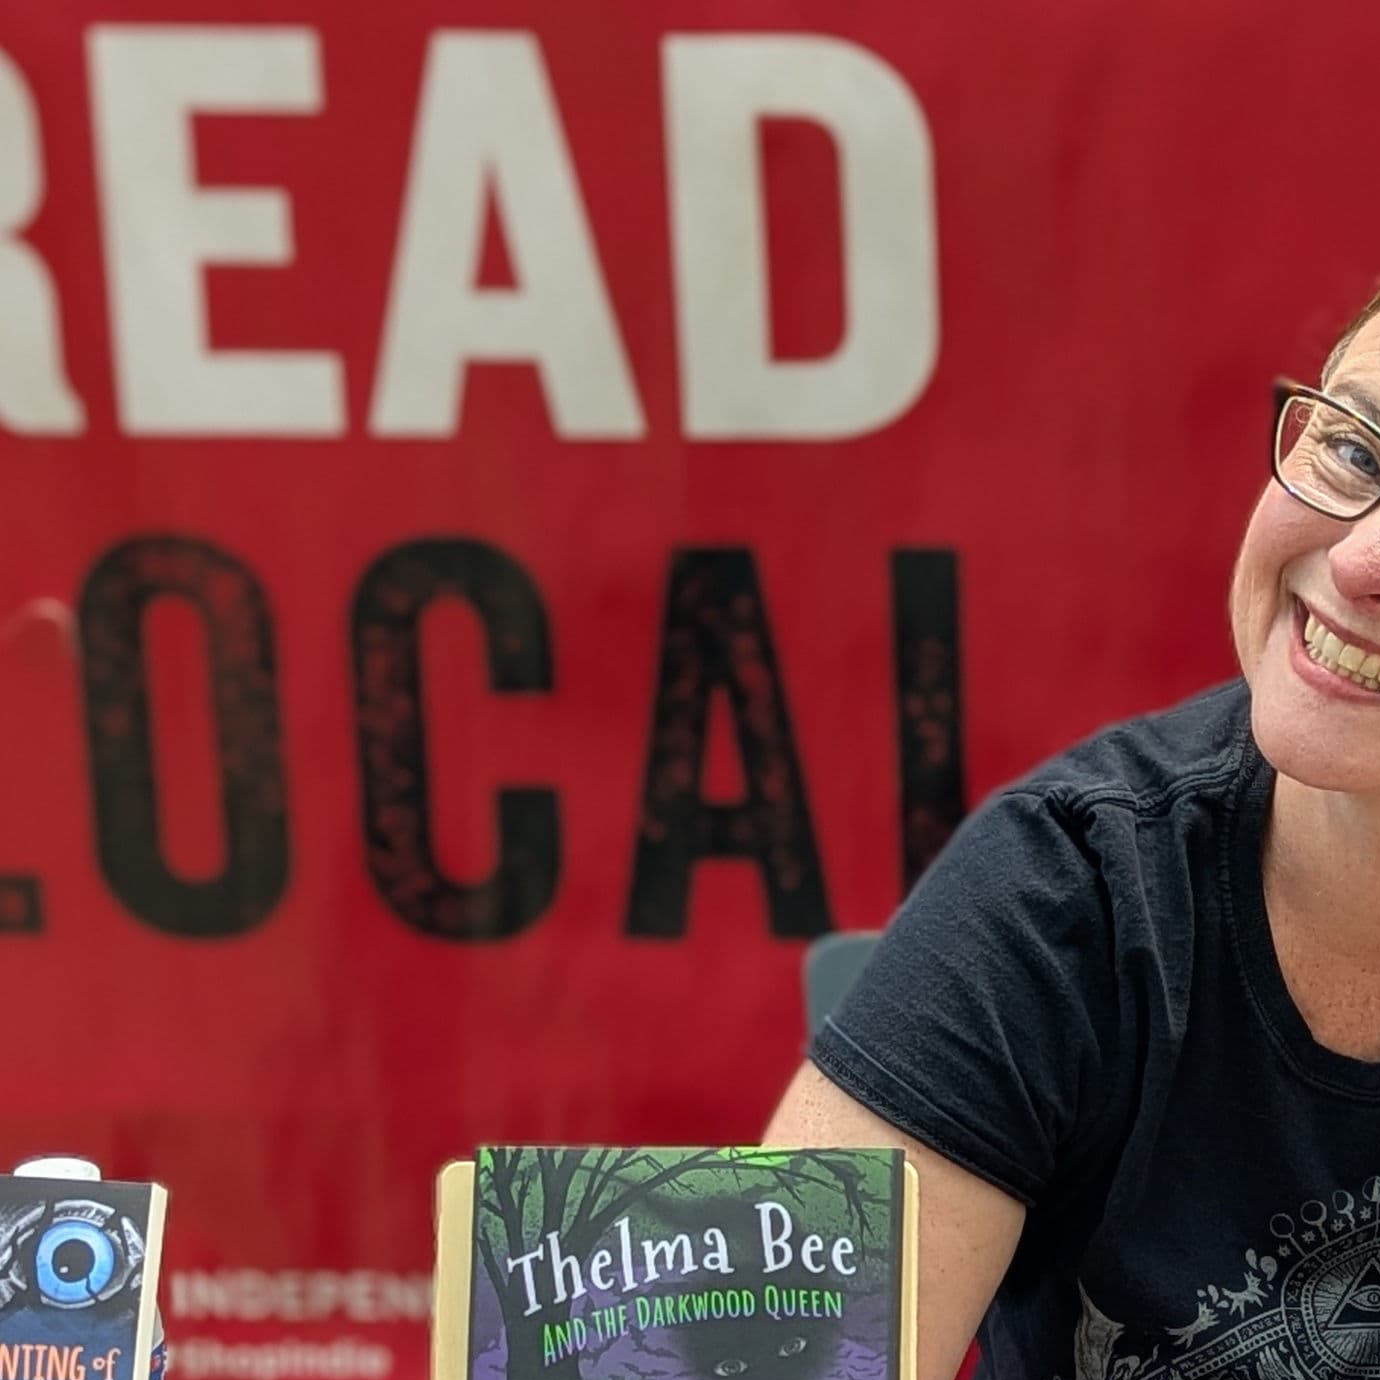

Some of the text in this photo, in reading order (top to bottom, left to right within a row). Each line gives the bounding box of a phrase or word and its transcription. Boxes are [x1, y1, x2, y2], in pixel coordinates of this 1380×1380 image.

[507, 1201, 857, 1318] Thelma Bee
[542, 1284, 844, 1367] AND THE DARKWOOD QUEEN
